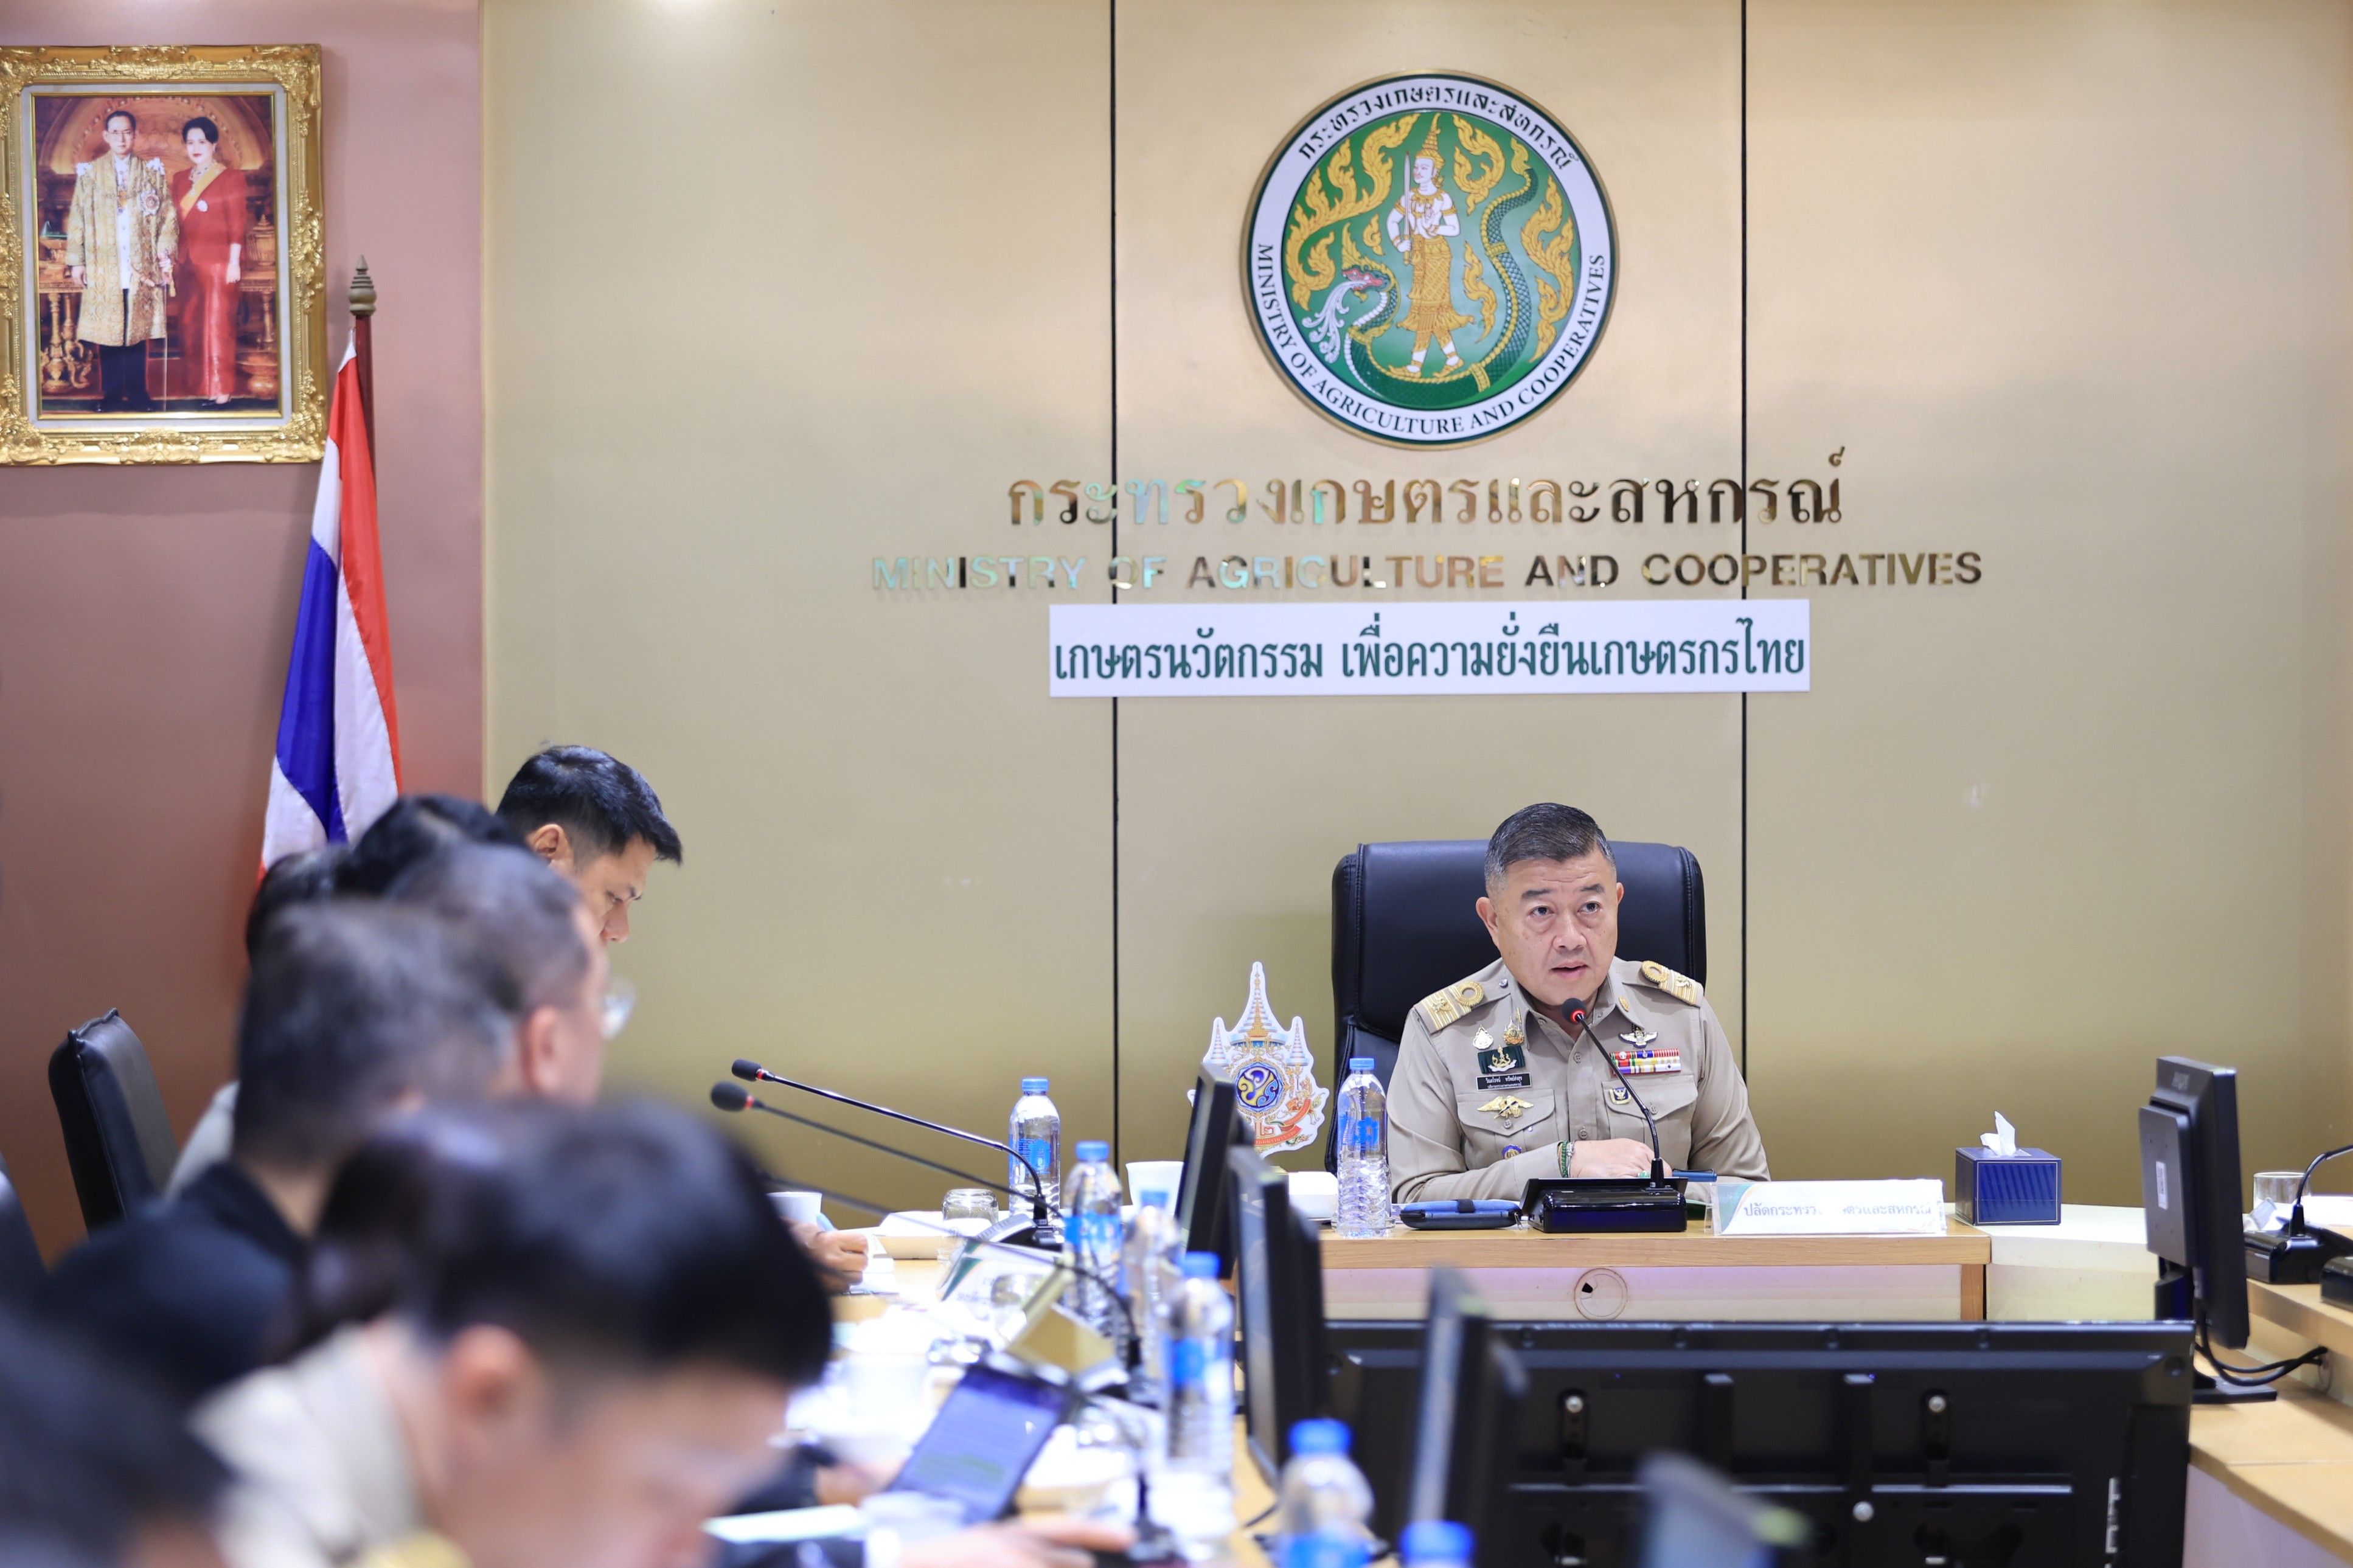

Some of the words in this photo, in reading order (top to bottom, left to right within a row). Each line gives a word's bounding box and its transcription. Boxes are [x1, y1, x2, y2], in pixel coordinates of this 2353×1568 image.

[1299, 86, 1579, 169] กระทรวงเกษตรและสหกรณ์
[1257, 244, 1297, 351] MINISTRY
[1290, 353, 1318, 384] OF
[1313, 378, 1464, 434] AGRICULTURE
[1470, 400, 1515, 429] AND
[1517, 254, 1606, 406] COOPERATIVES
[1007, 446, 1845, 526] กระทรวงเกษตรและสหกรณ์
[872, 557, 1087, 589] MINISTRY
[1108, 557, 1167, 589] OF
[1187, 555, 1505, 589] AGRICULTURE
[1524, 554, 1620, 587] AND
[1642, 552, 1983, 587] COOPERATIVES
[1055, 627, 1323, 679] เกษตรนวัตกรรม
[1343, 611, 1805, 678] เพื่อความยั่งยืนเกษตรกรไทย
